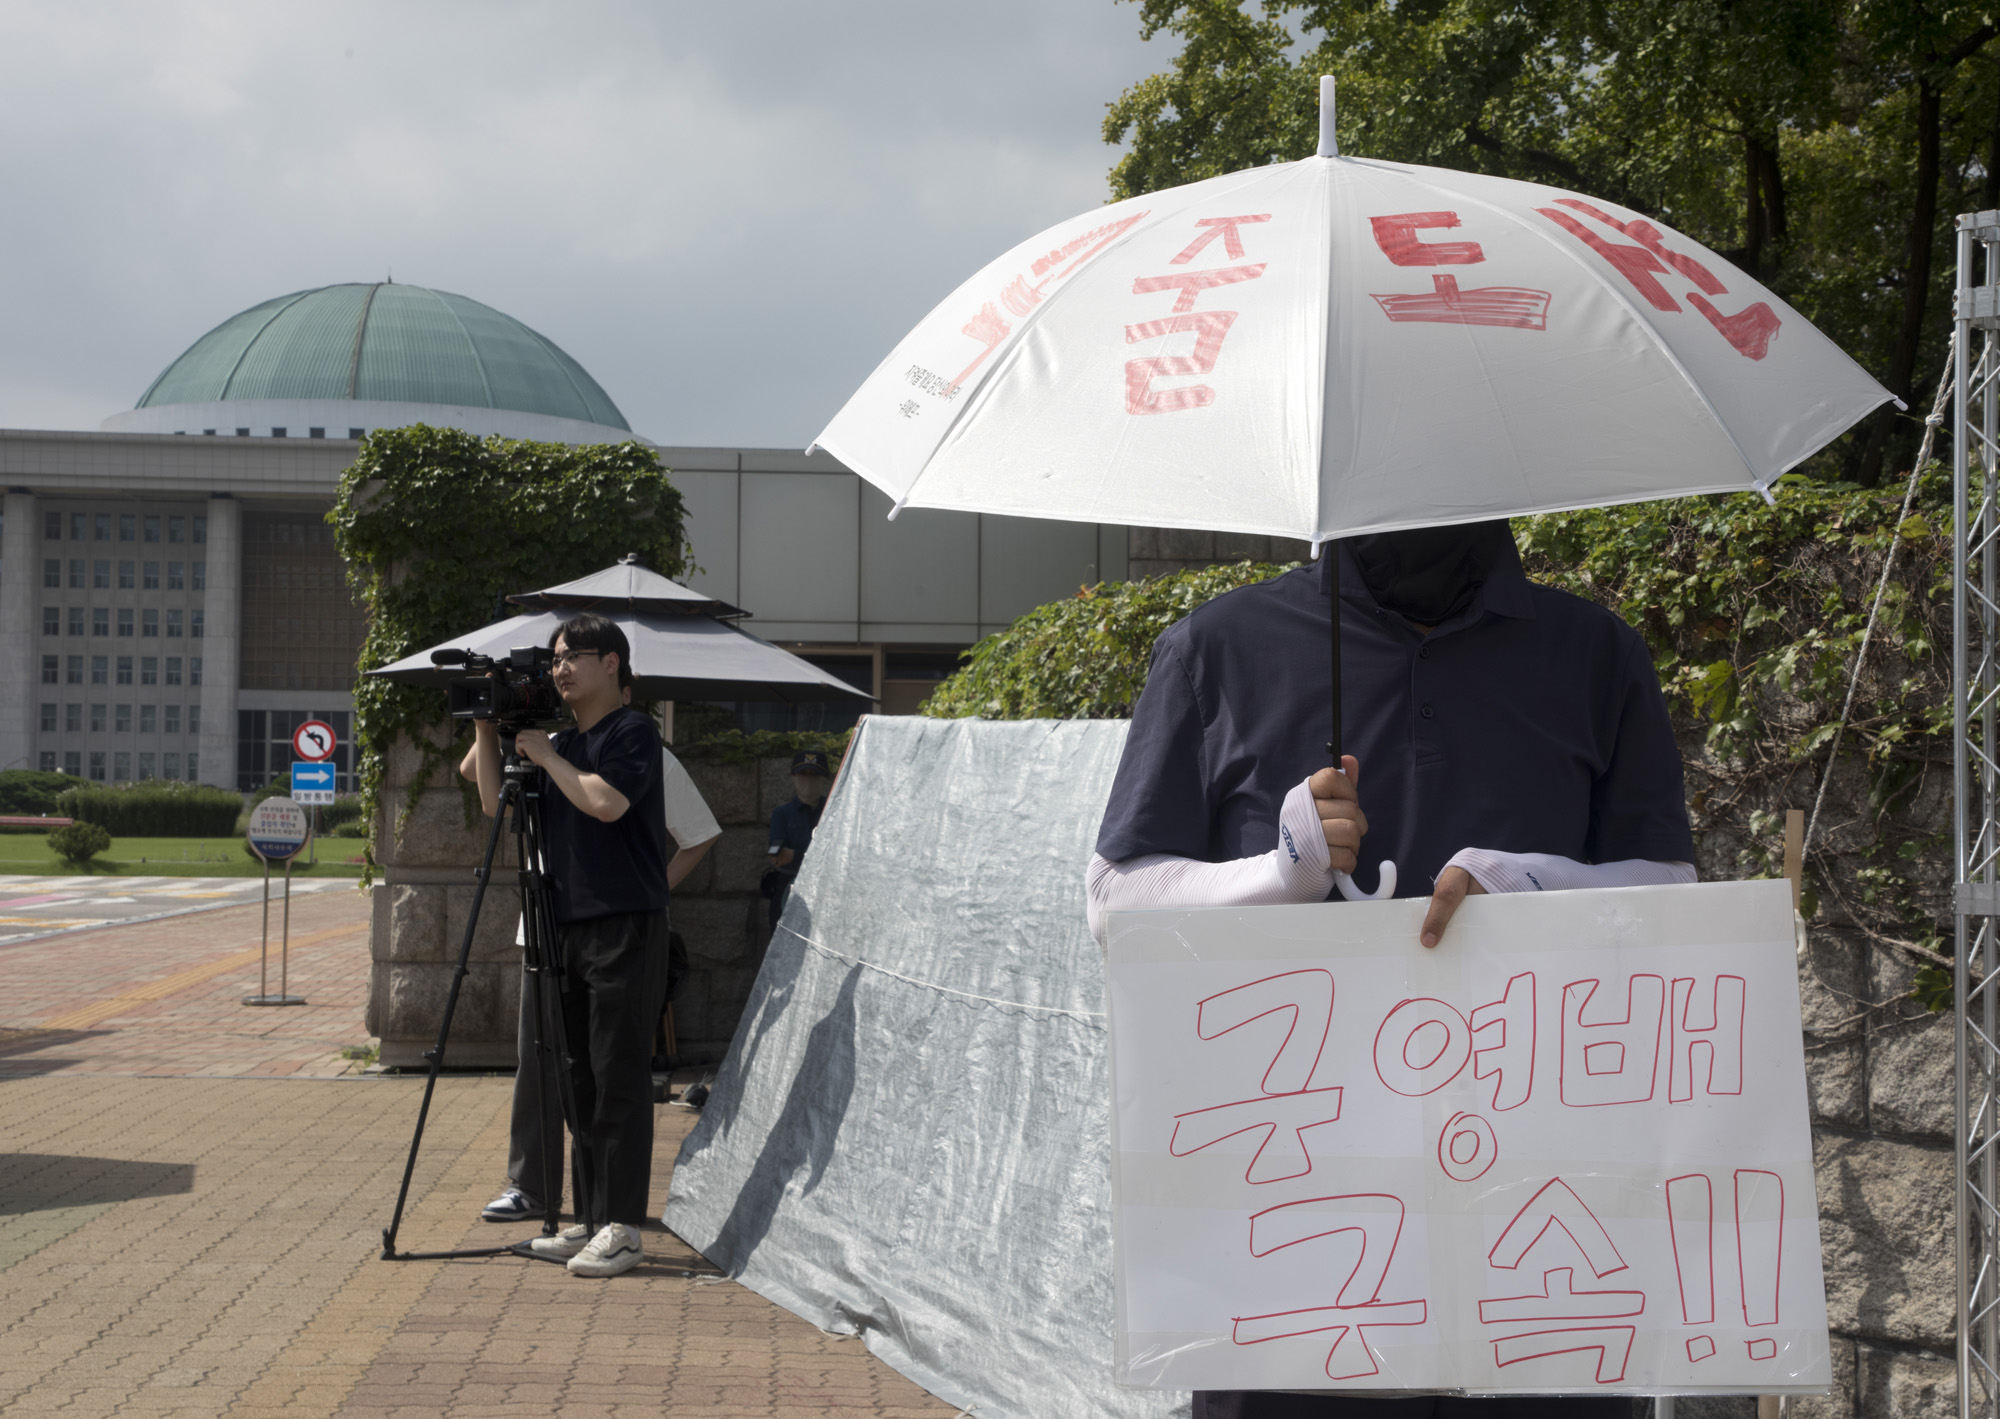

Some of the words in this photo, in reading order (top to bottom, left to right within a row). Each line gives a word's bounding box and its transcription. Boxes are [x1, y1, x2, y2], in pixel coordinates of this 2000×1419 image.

[294, 792, 332, 801] 일방통행
[1169, 968, 1746, 1184] 구영배
[1231, 1168, 1784, 1384] 구속!!
